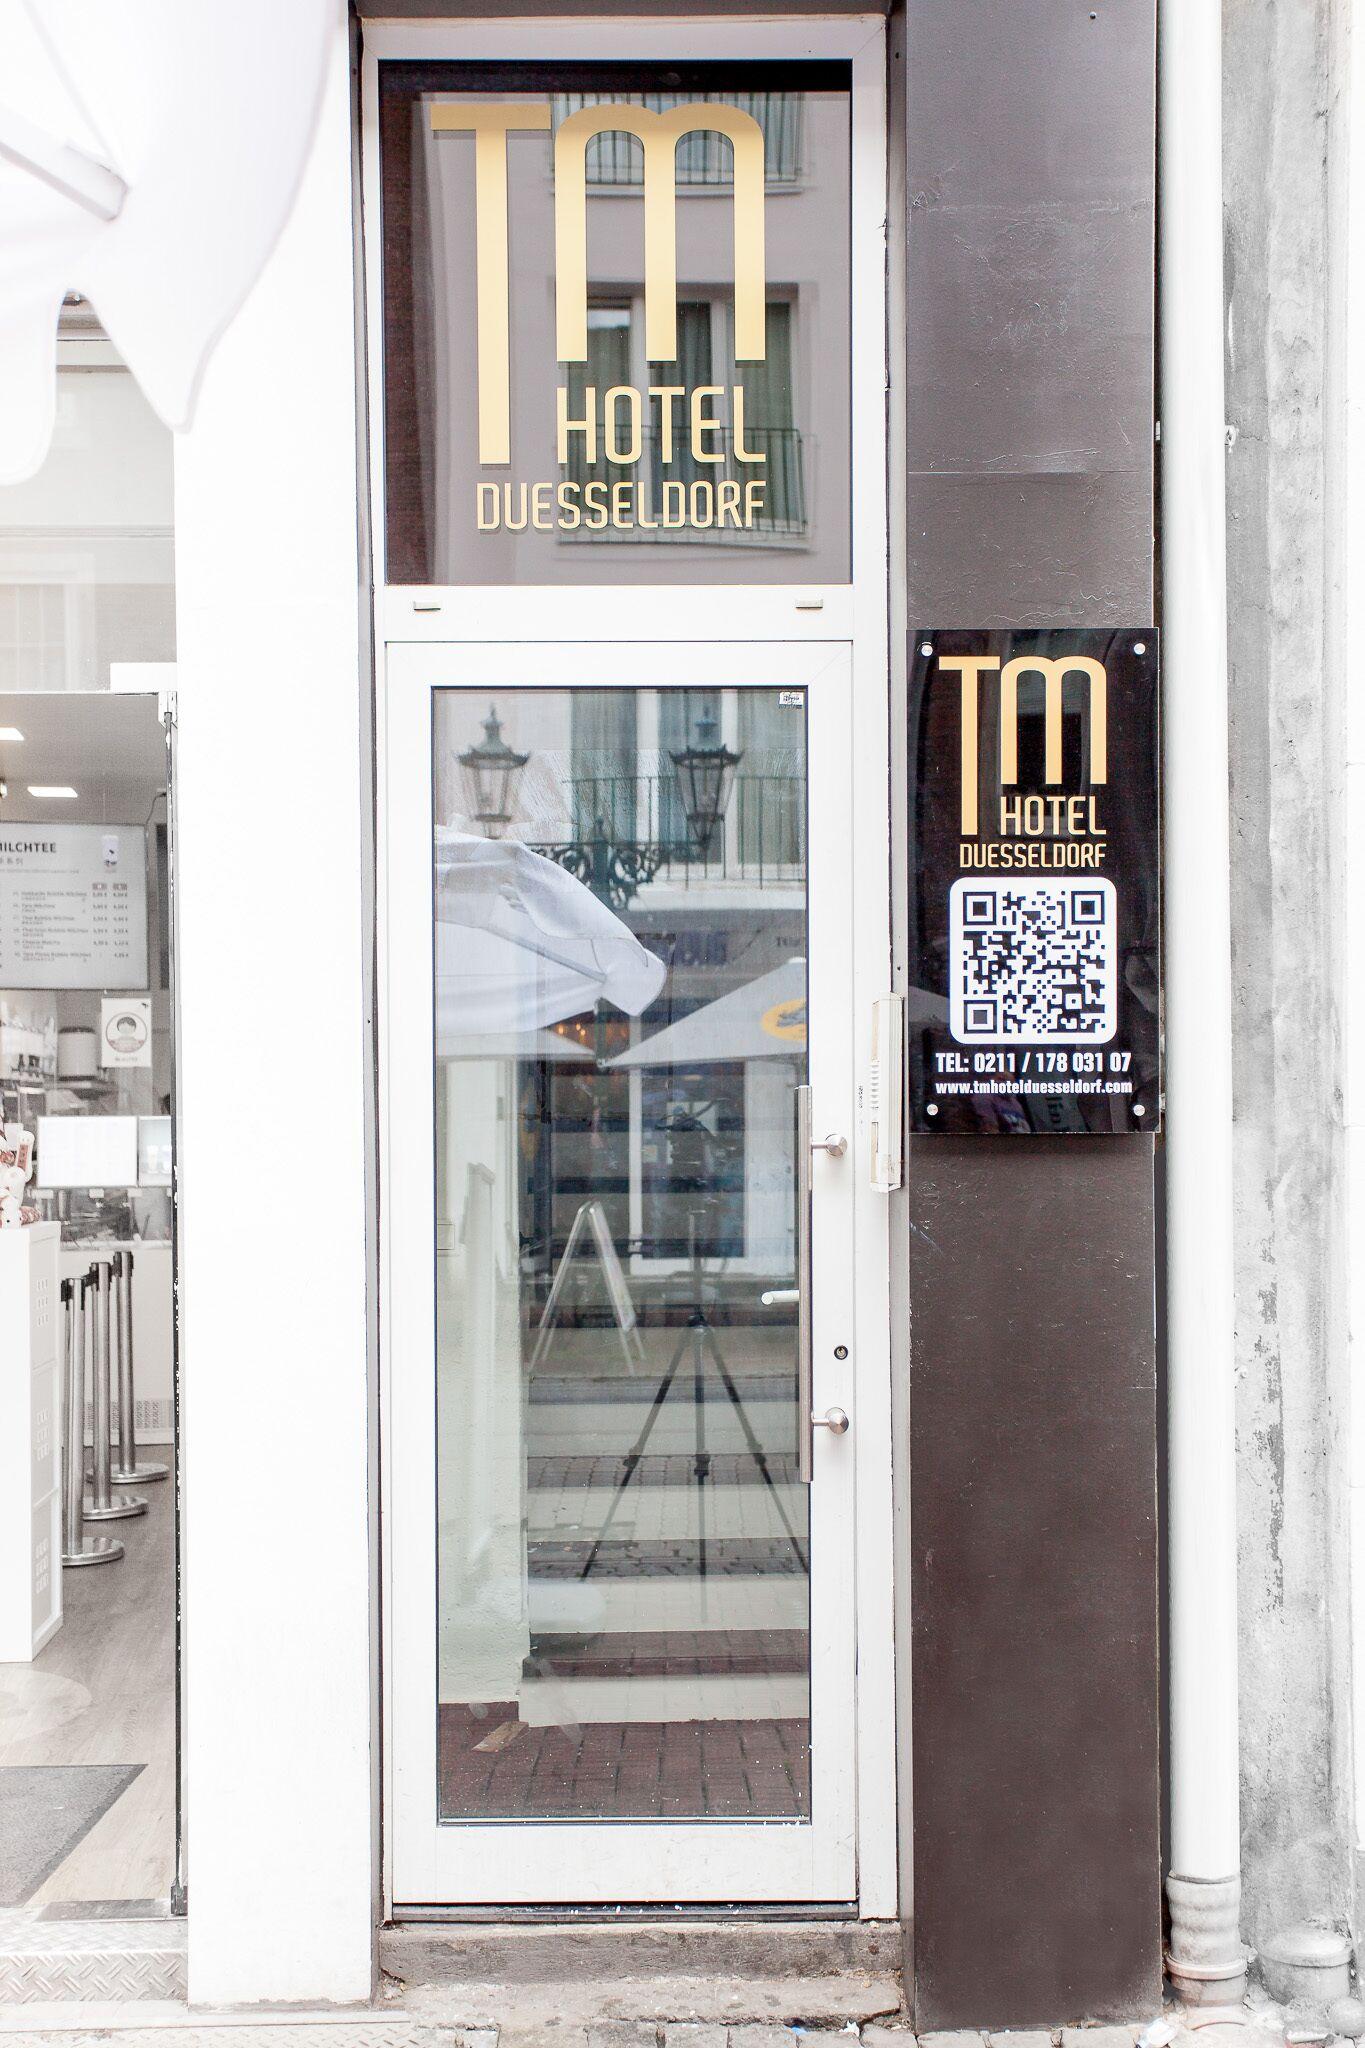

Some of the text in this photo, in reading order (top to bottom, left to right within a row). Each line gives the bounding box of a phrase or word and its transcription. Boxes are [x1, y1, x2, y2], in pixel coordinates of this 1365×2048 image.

[556, 385, 767, 465] HOTEL
[476, 480, 767, 530] DUESSELDORF
[1000, 795, 1107, 836] HOTEL
[959, 843, 1106, 869] DUESSELDORF
[935, 1052, 1132, 1073] TEL: 0211 / 178 031 07
[935, 1079, 1133, 1094] www.tmhotelduesseldorf.com
